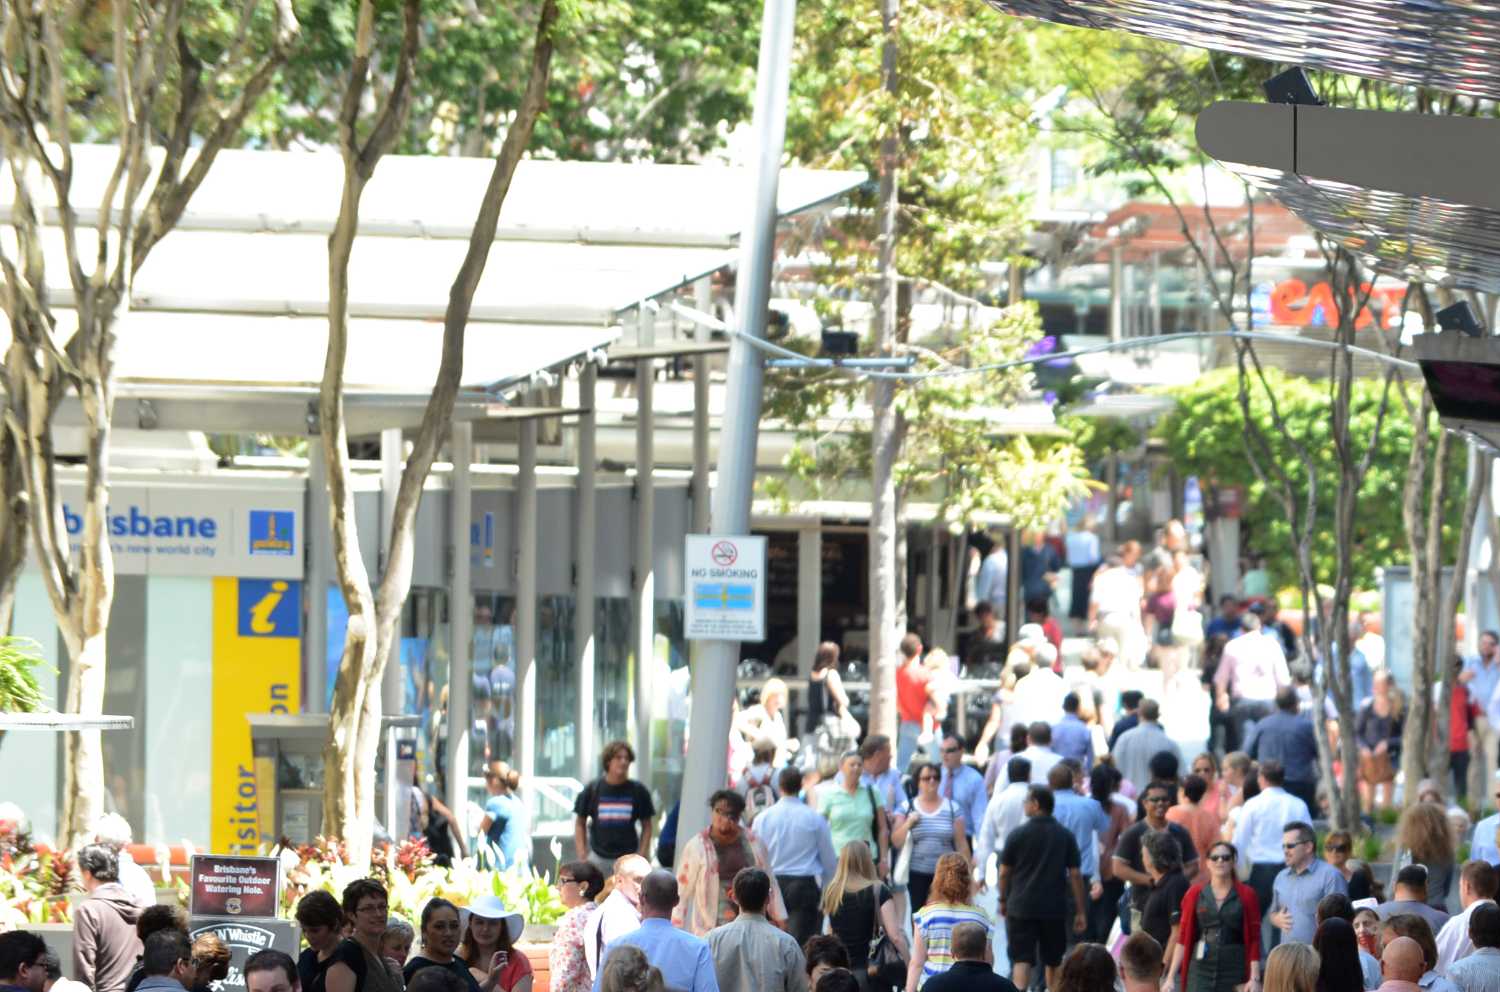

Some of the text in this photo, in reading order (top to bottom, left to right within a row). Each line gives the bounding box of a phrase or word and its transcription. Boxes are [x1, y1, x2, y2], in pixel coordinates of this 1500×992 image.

[63, 504, 217, 538] bsbane
[691, 568, 758, 579] NO SMOKING
[229, 764, 258, 853] isitor
[213, 864, 257, 874] Brisbane's
[198, 874, 272, 885] Favourite Outdoor
[205, 884, 242, 896] Watering
[229, 928, 267, 946] Whistle
